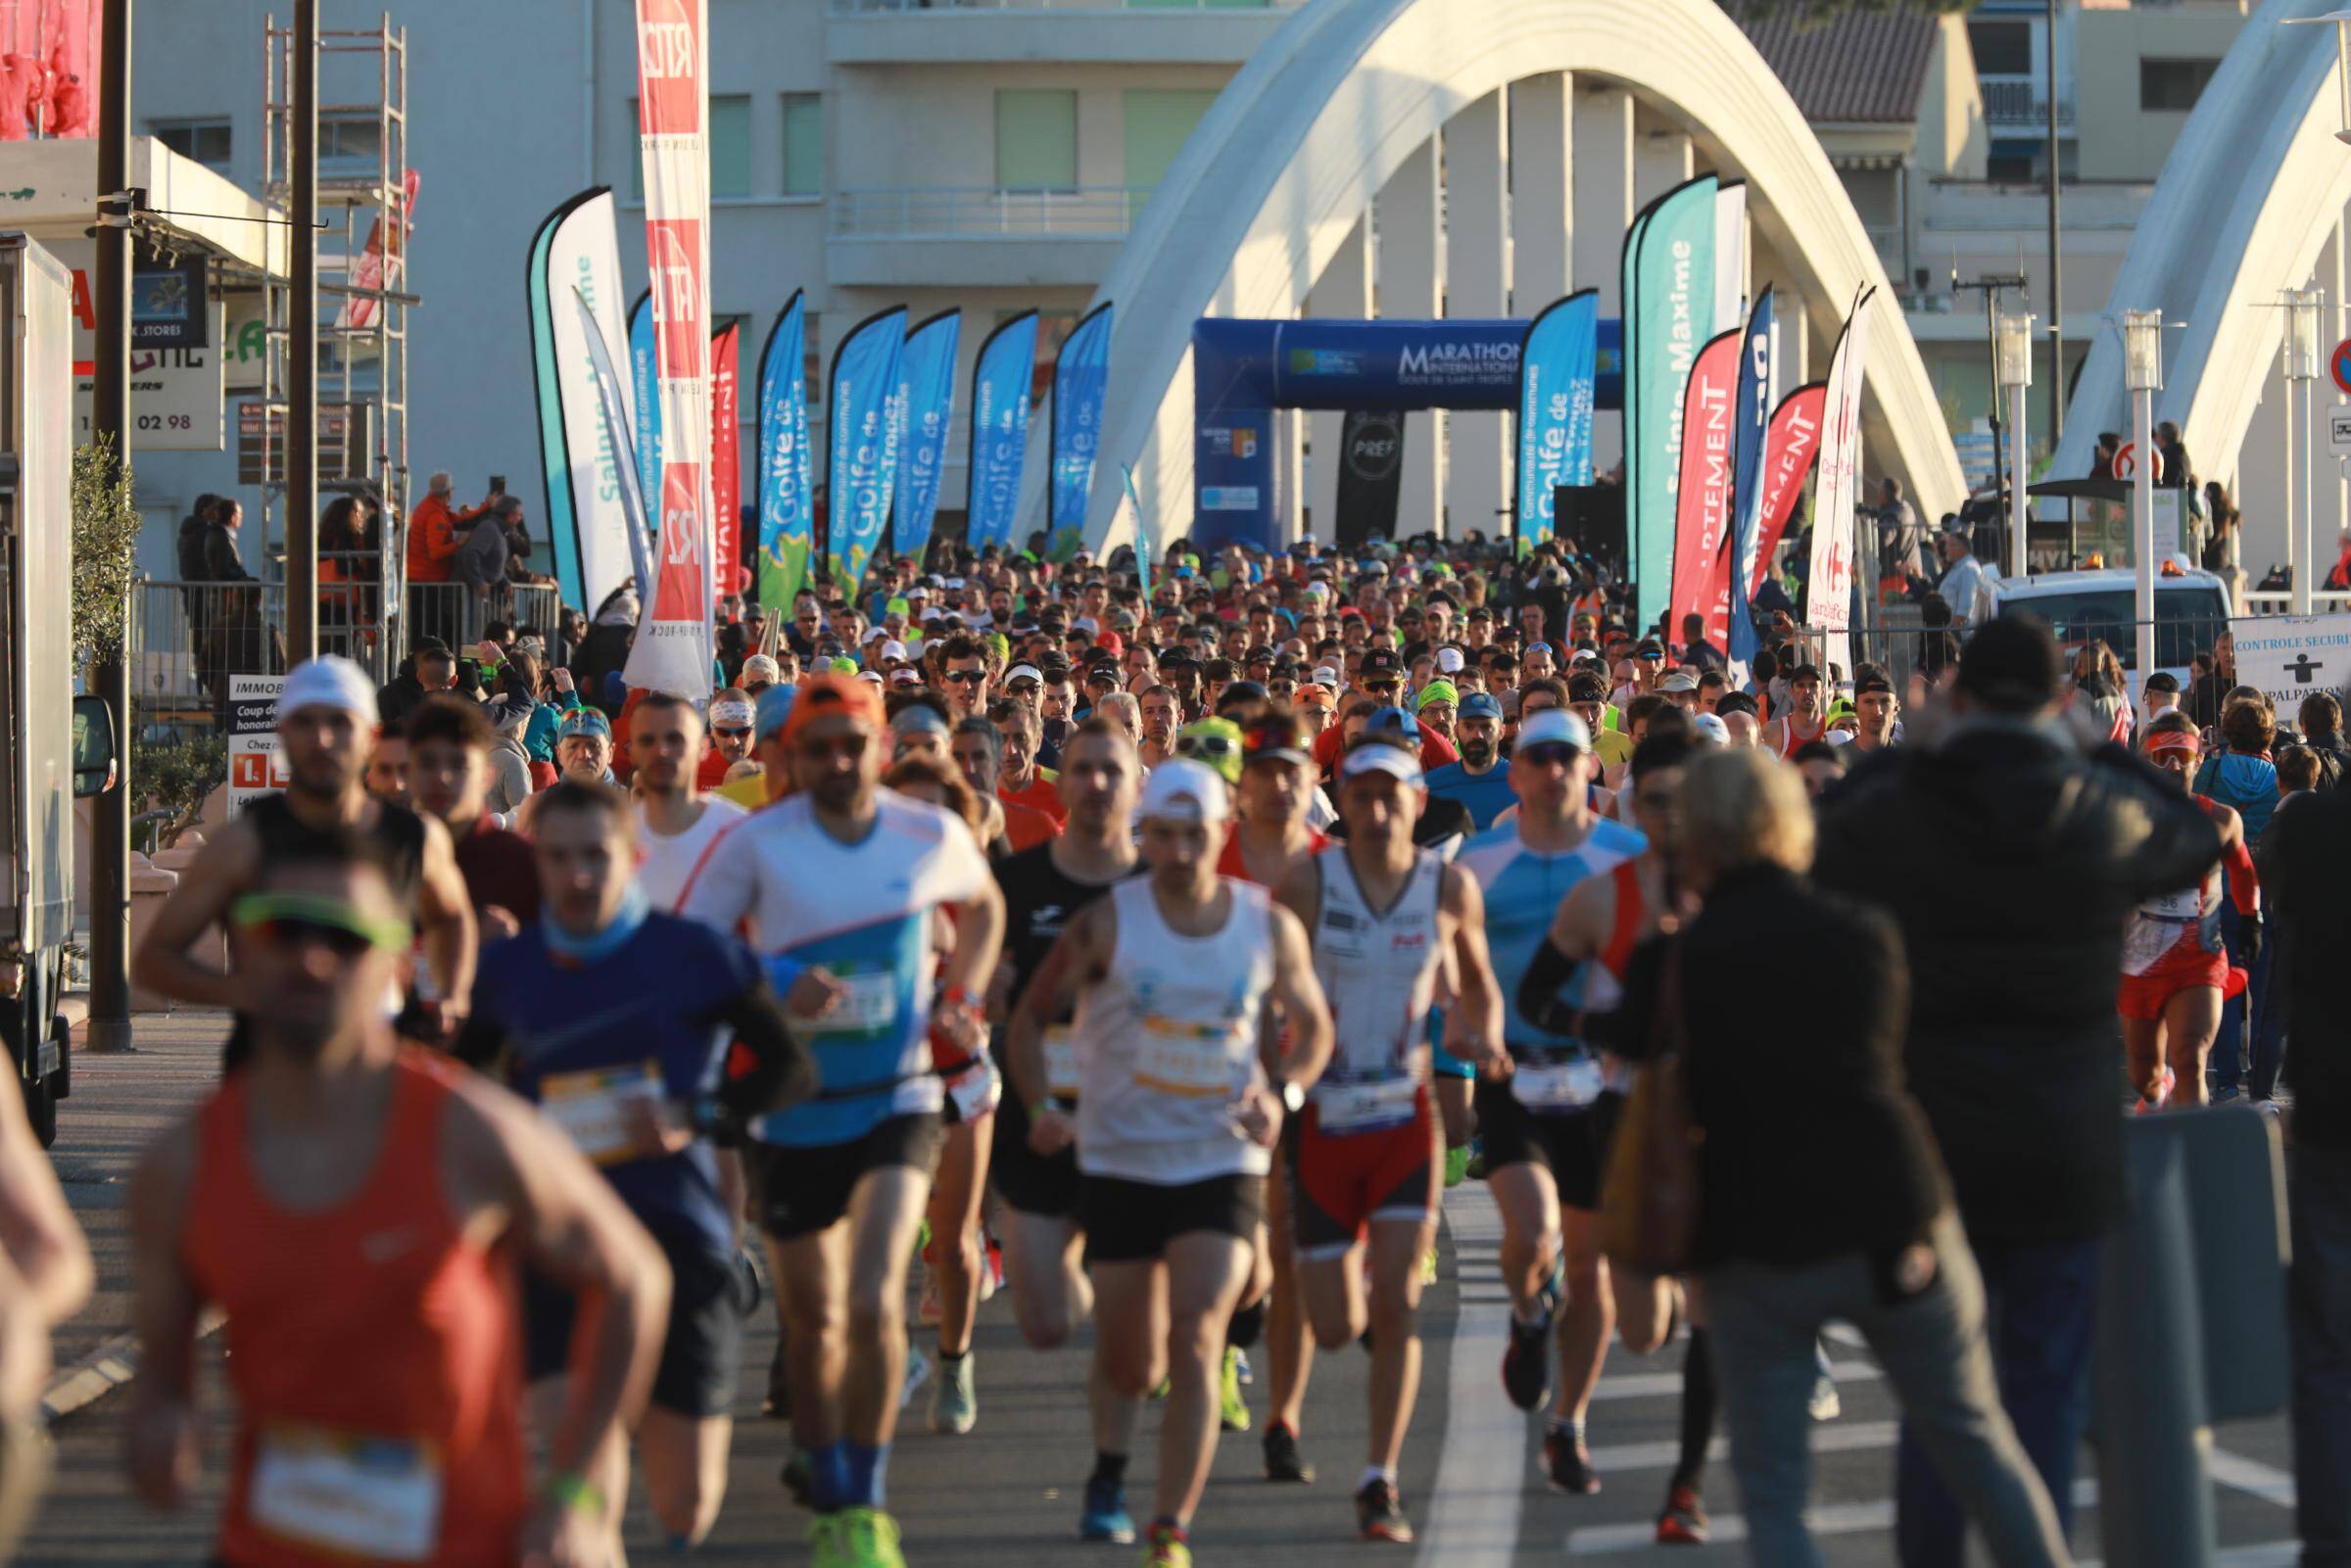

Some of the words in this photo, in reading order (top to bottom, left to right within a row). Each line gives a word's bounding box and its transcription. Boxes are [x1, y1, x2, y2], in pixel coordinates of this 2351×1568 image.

[1526, 364, 1539, 428] communes
[1547, 392, 1567, 421] de
[138, 415, 162, 430] 02
[168, 415, 191, 430] 98
[862, 410, 879, 438] de
[922, 409, 939, 439] de
[772, 432, 798, 524] Golfe
[850, 445, 878, 538] Golfe
[1523, 445, 1536, 519] Communauté
[2234, 638, 2303, 652] CONTROLE
[2305, 634, 2351, 647] SECURI
[237, 705, 264, 718] Coup
[265, 704, 279, 715] de
[247, 739, 270, 750] Chez
